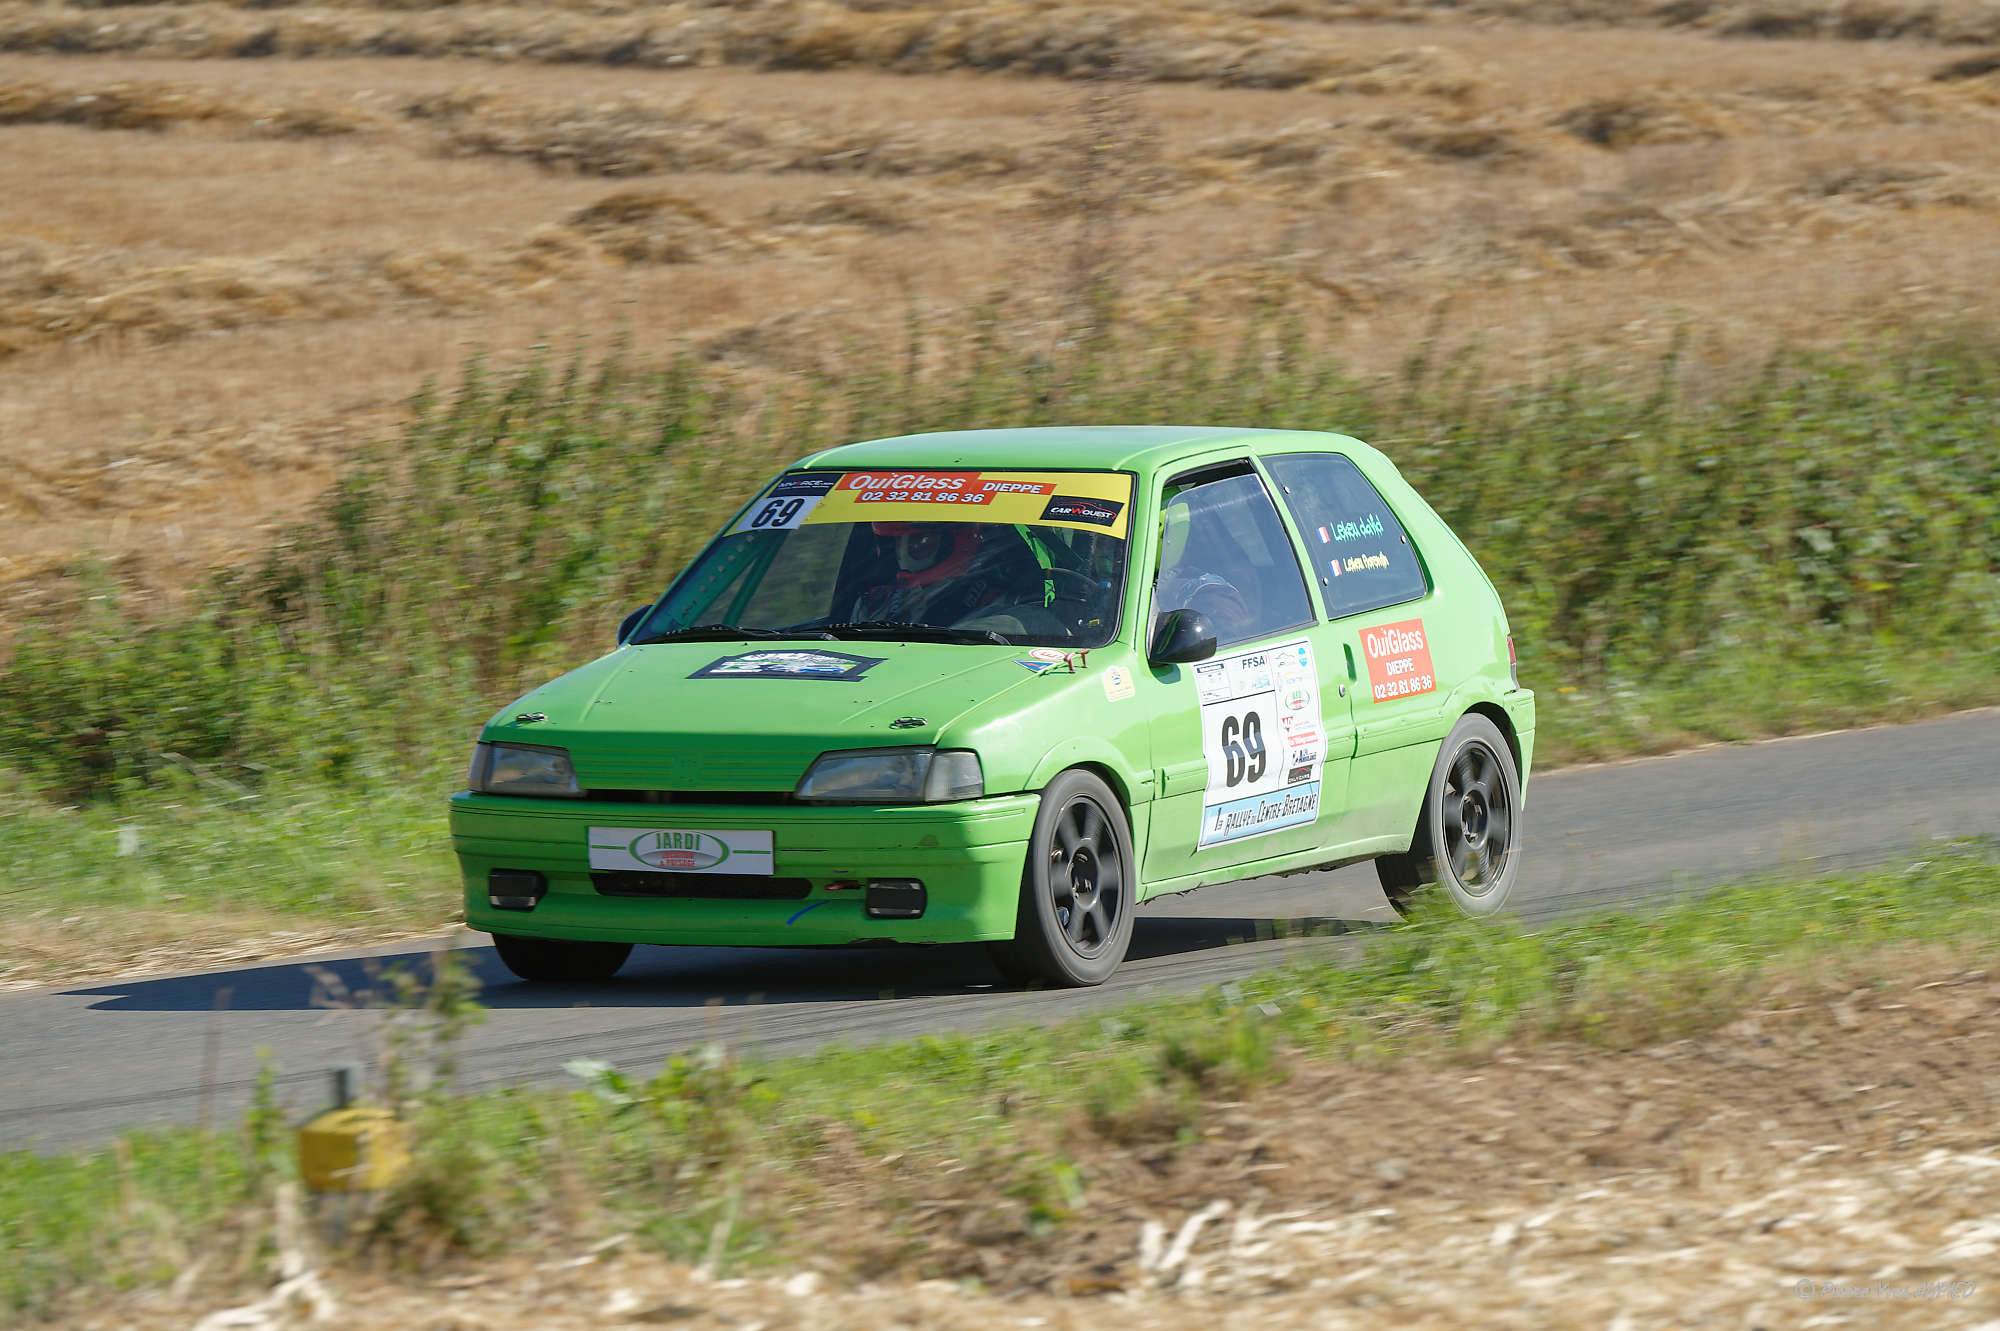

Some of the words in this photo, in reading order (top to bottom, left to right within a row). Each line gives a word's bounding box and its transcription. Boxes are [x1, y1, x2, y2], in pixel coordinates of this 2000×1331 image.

[849, 472, 967, 490] OuiGlass
[982, 482, 1044, 494] DIEPPE
[861, 491, 882, 501] 02
[886, 491, 907, 501] 32
[910, 491, 932, 502] 81
[935, 492, 957, 502] 86
[961, 492, 985, 503] 36
[751, 498, 805, 528] 69
[1367, 627, 1424, 658] OuiGlass
[1242, 655, 1265, 670] FFSA
[1385, 657, 1415, 676] DIEPPE
[1374, 684, 1387, 699] 02
[1387, 681, 1398, 697] 32
[1399, 679, 1410, 695] 81
[1410, 677, 1421, 692] 86
[1421, 674, 1433, 690] 36
[1221, 711, 1267, 788] 69
[1224, 809, 1252, 837] RALLYE
[655, 832, 701, 850] JARDI
